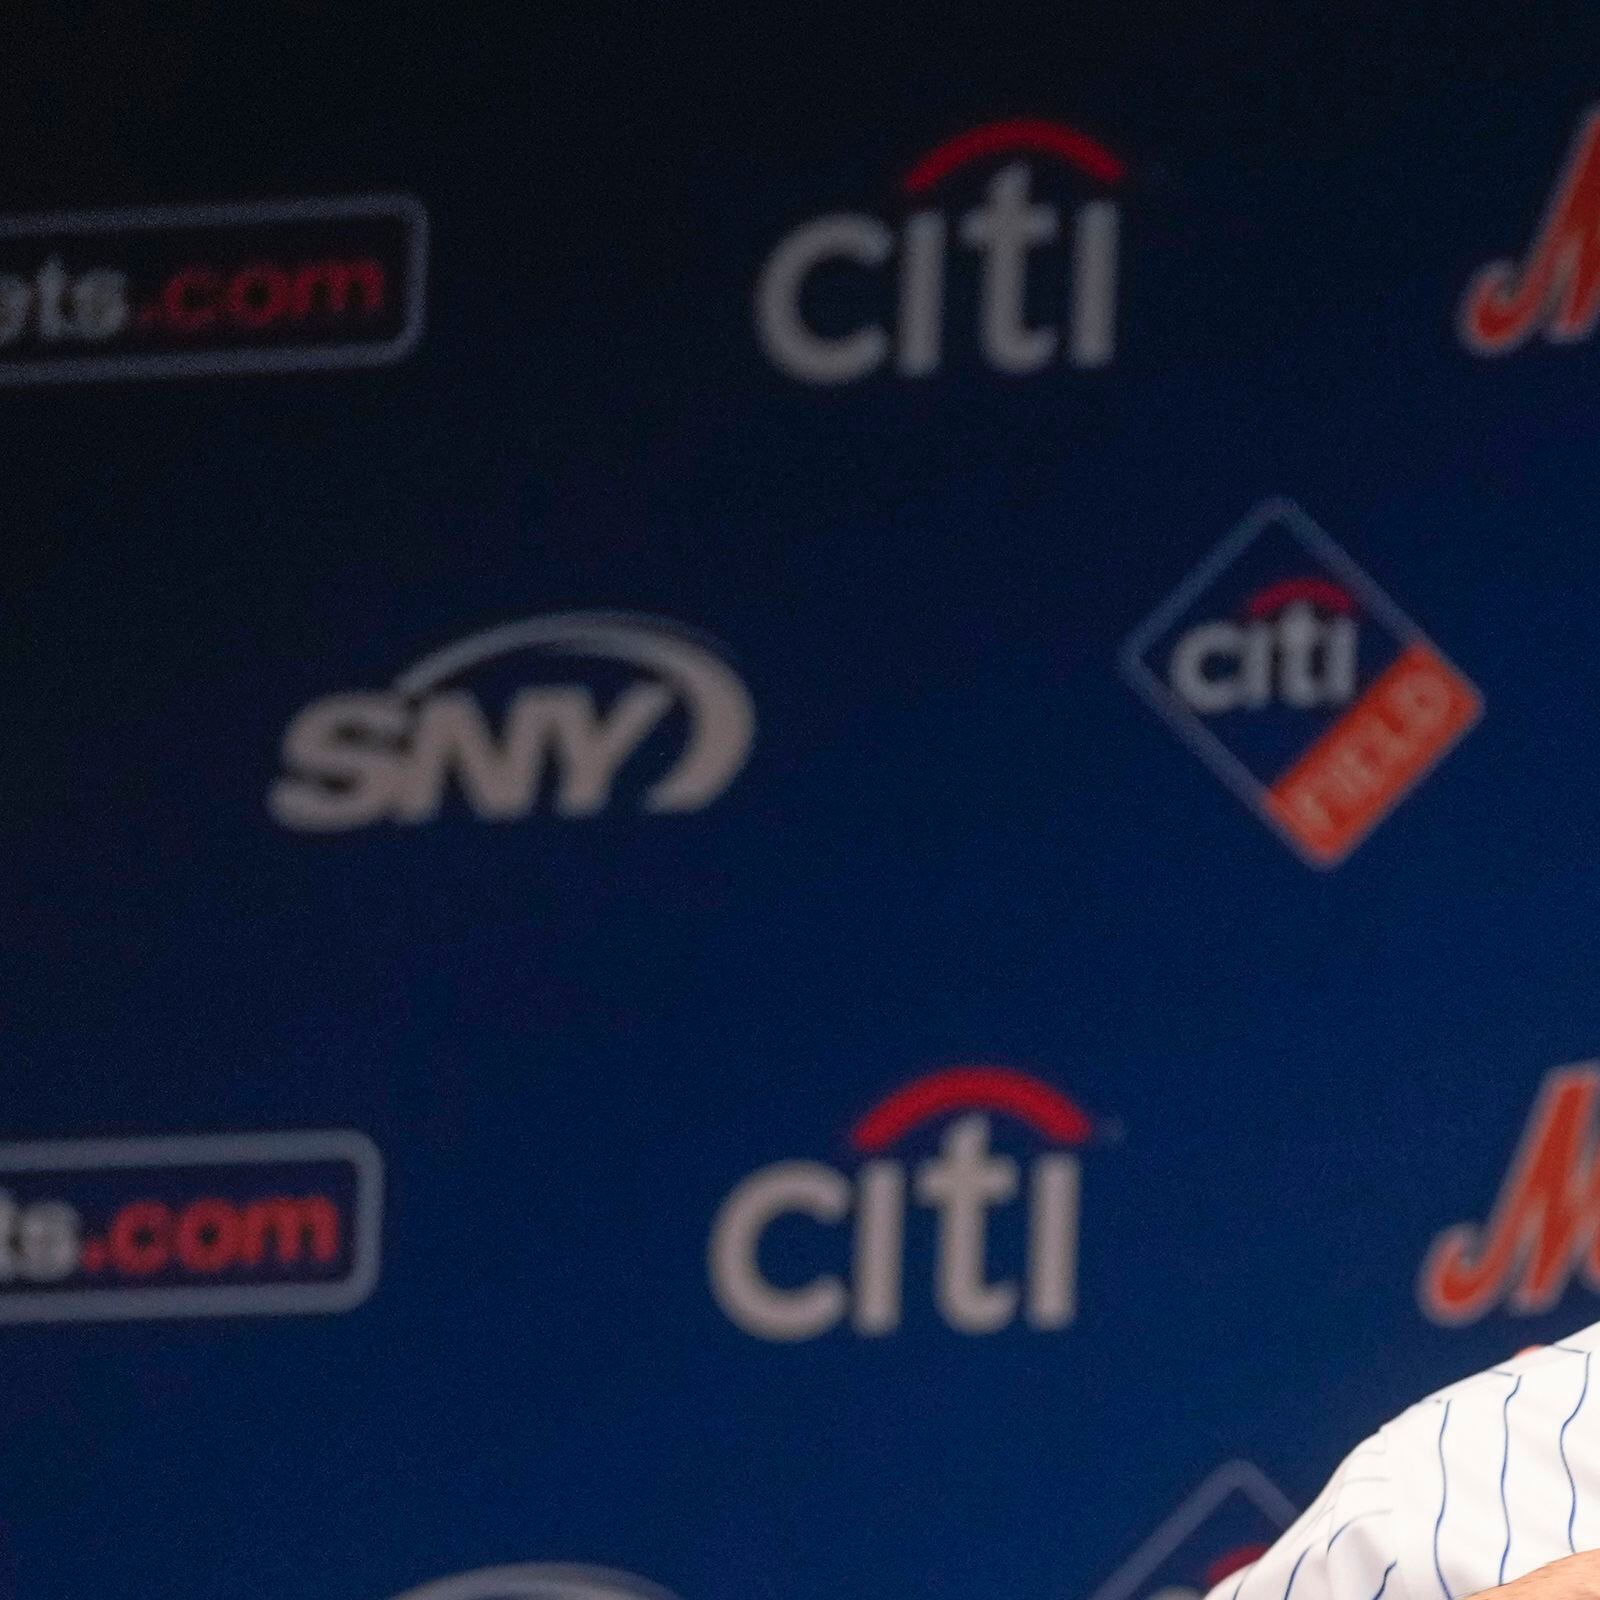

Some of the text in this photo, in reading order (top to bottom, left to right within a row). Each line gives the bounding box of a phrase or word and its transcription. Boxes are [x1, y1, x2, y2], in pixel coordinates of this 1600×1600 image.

[755, 165, 1120, 384] citi
[1169, 600, 1358, 713] citi
[270, 682, 676, 830] SNY
[709, 1115, 1080, 1340] citi
